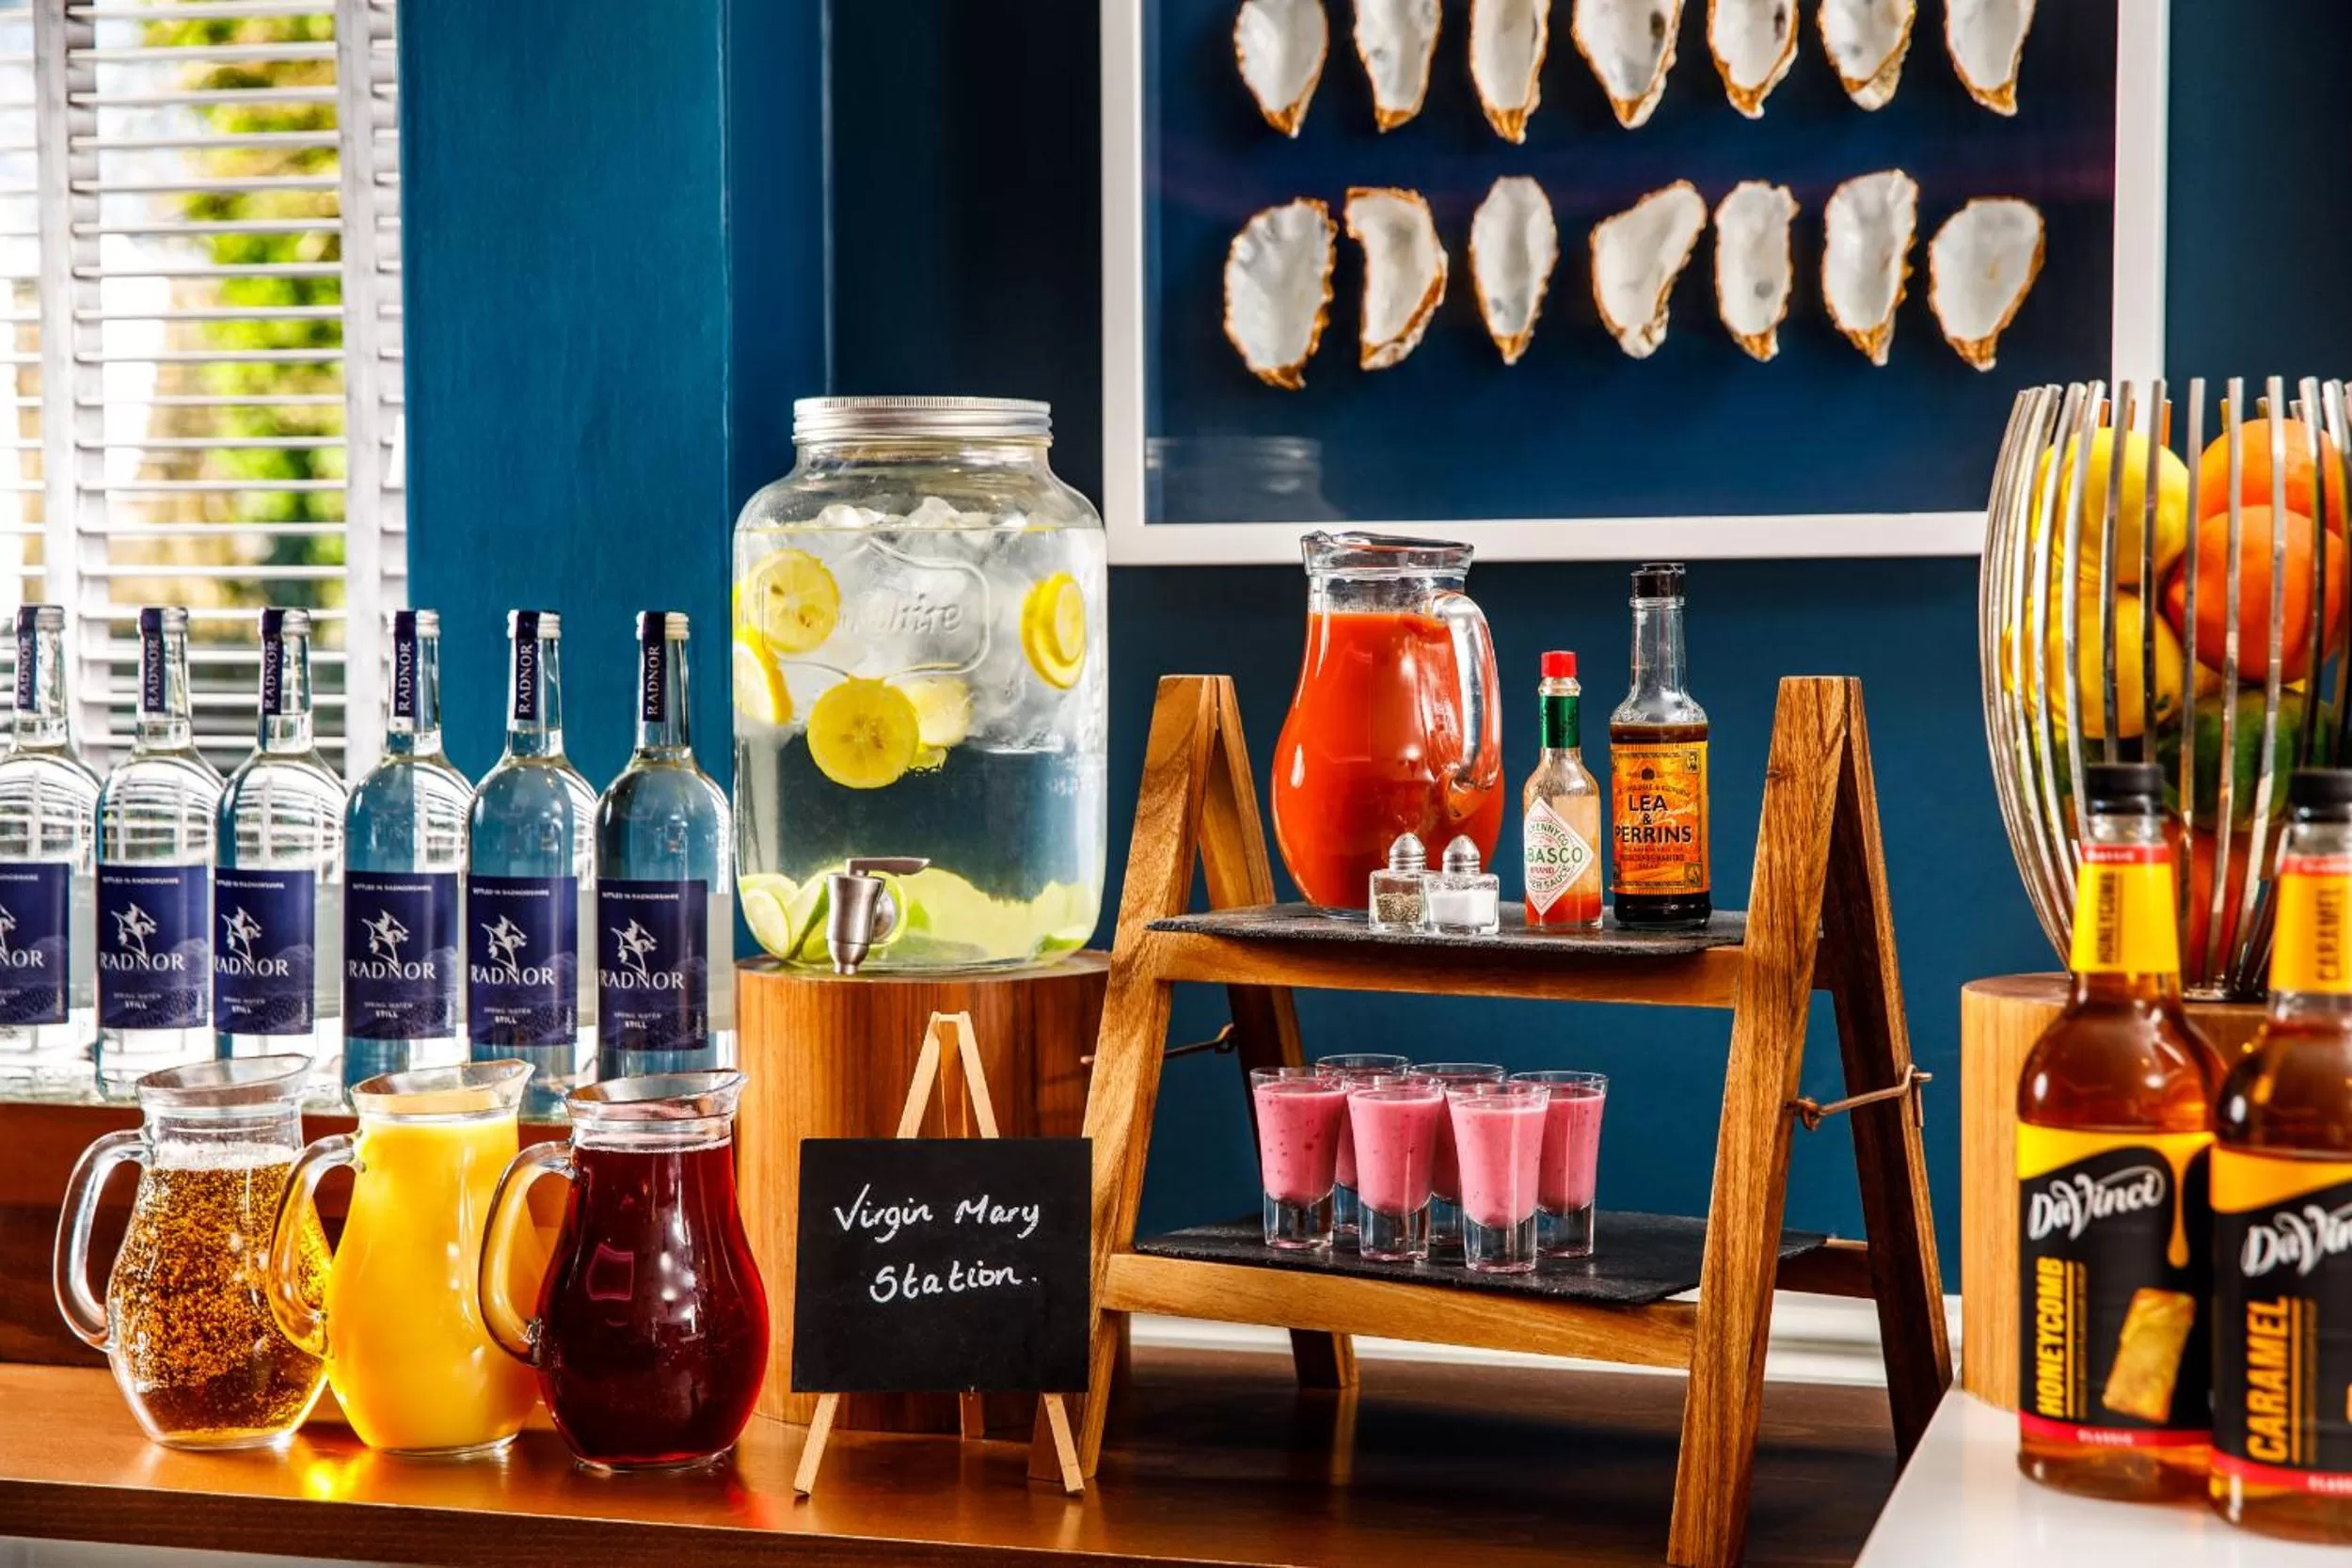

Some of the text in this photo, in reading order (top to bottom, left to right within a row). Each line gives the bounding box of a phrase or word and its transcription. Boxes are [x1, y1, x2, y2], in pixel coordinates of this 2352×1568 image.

[264, 641, 278, 709] RADNOR
[398, 641, 411, 711] RADNOR
[519, 644, 533, 713] RADNOR
[647, 645, 660, 715] RADNOR
[1628, 794, 1669, 812] LEA
[1643, 813, 1653, 826] &
[1614, 825, 1692, 844] PERRINS
[99, 951, 186, 973] RADNOR
[348, 958, 437, 980] RADNOR
[470, 964, 555, 987] RADNOR
[599, 968, 686, 990] RADNOR
[833, 1182, 1040, 1243] Virgin Mary
[2027, 1164, 2166, 1242] DaVinci
[2036, 1256, 2065, 1418] HONEYCOMB
[2247, 1294, 2289, 1464] CARAMEL
